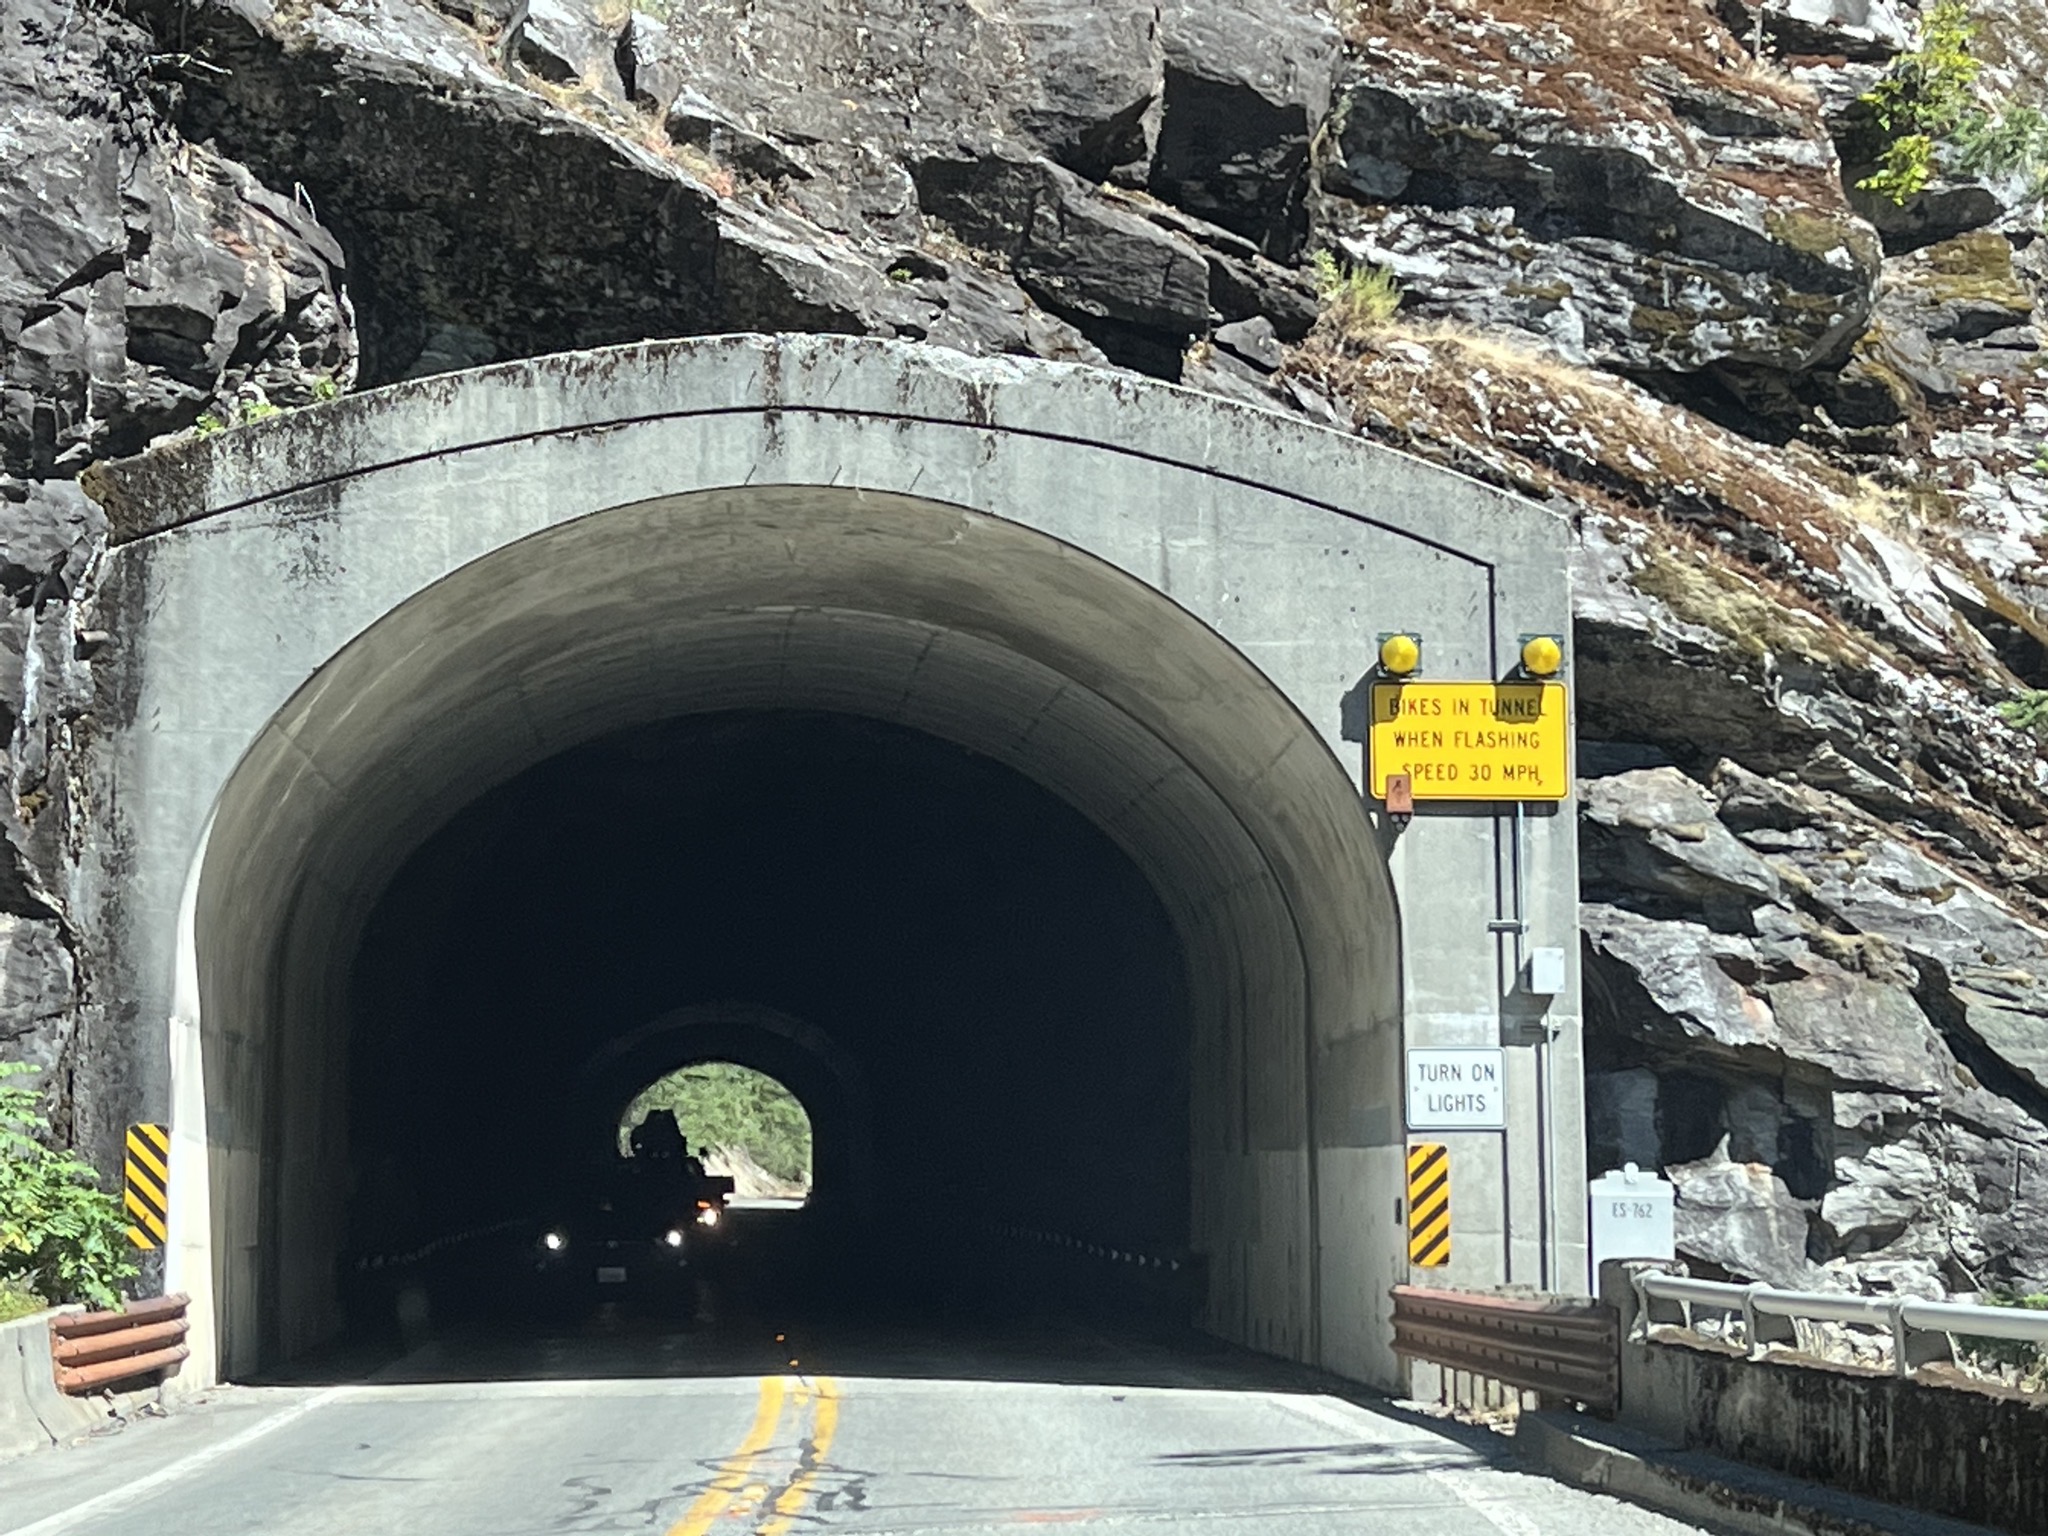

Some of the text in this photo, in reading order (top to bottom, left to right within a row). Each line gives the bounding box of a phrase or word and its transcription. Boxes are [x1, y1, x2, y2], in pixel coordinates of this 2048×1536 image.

[1389, 698, 1547, 717] BIKES IN TUNNEL
[1394, 731, 1541, 750] WHEN FLASHING
[1469, 764, 1491, 781] 30
[1503, 764, 1540, 782] MPH
[1418, 1063, 1495, 1082] TURN ON
[1428, 1094, 1486, 1112] LIGHTS
